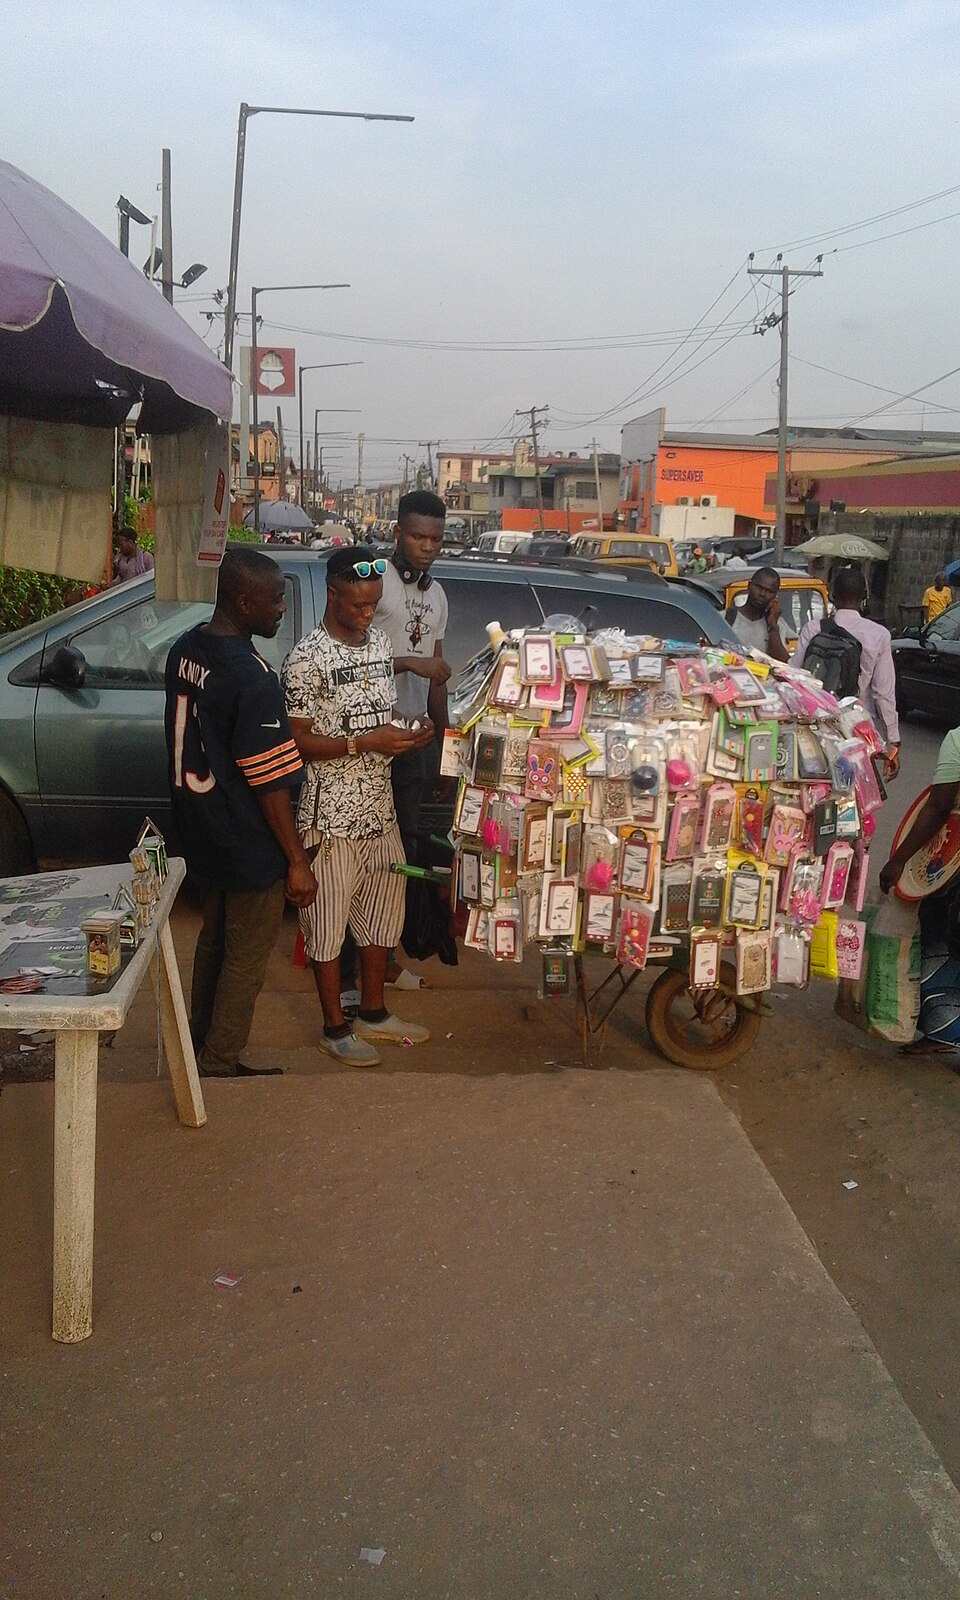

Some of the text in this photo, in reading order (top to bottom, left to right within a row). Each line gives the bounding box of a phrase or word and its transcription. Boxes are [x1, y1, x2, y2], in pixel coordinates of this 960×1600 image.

[661, 468, 704, 482] SUPERSAVER
[178, 656, 211, 690] KNOX
[349, 713, 377, 730] GOOD
